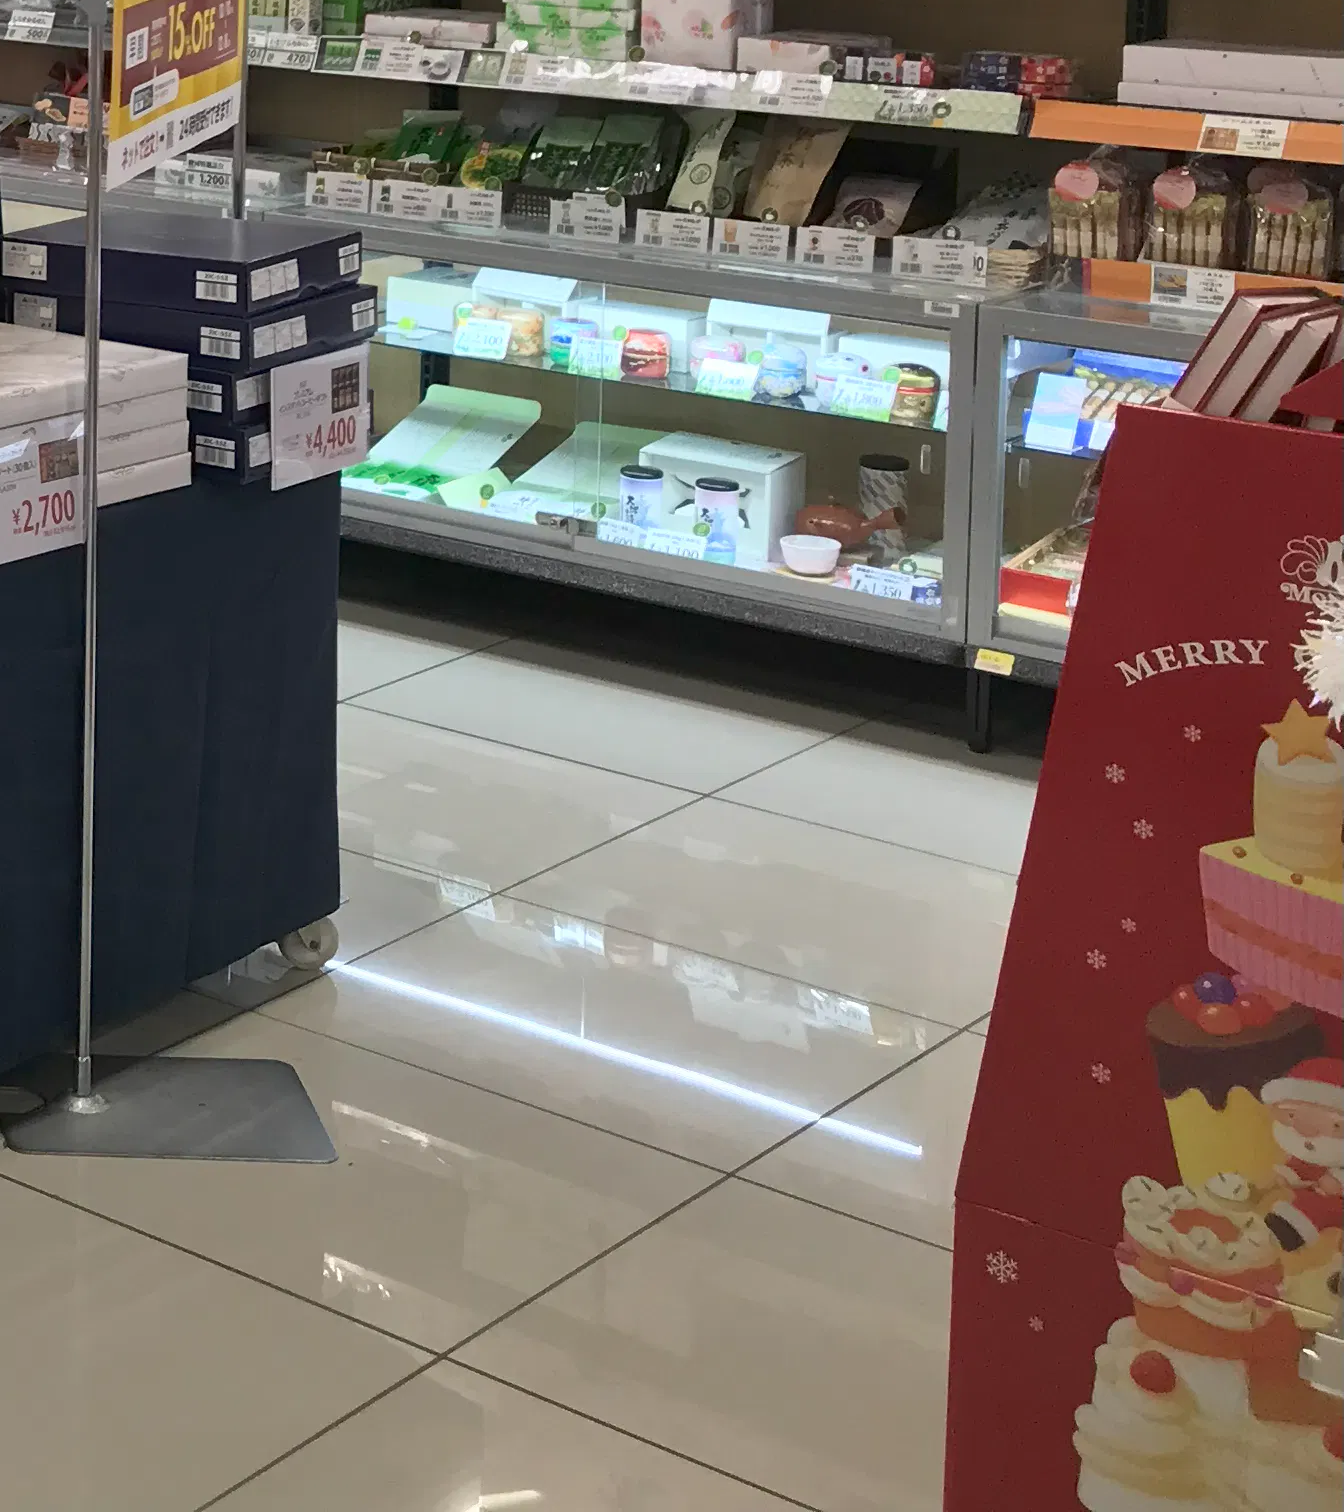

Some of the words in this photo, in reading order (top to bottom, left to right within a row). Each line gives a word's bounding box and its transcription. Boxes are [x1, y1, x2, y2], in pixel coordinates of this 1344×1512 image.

[306, 414, 356, 454] ¥4,400
[12, 490, 76, 536] ¥2,700
[1115, 639, 1270, 686] MERRY
